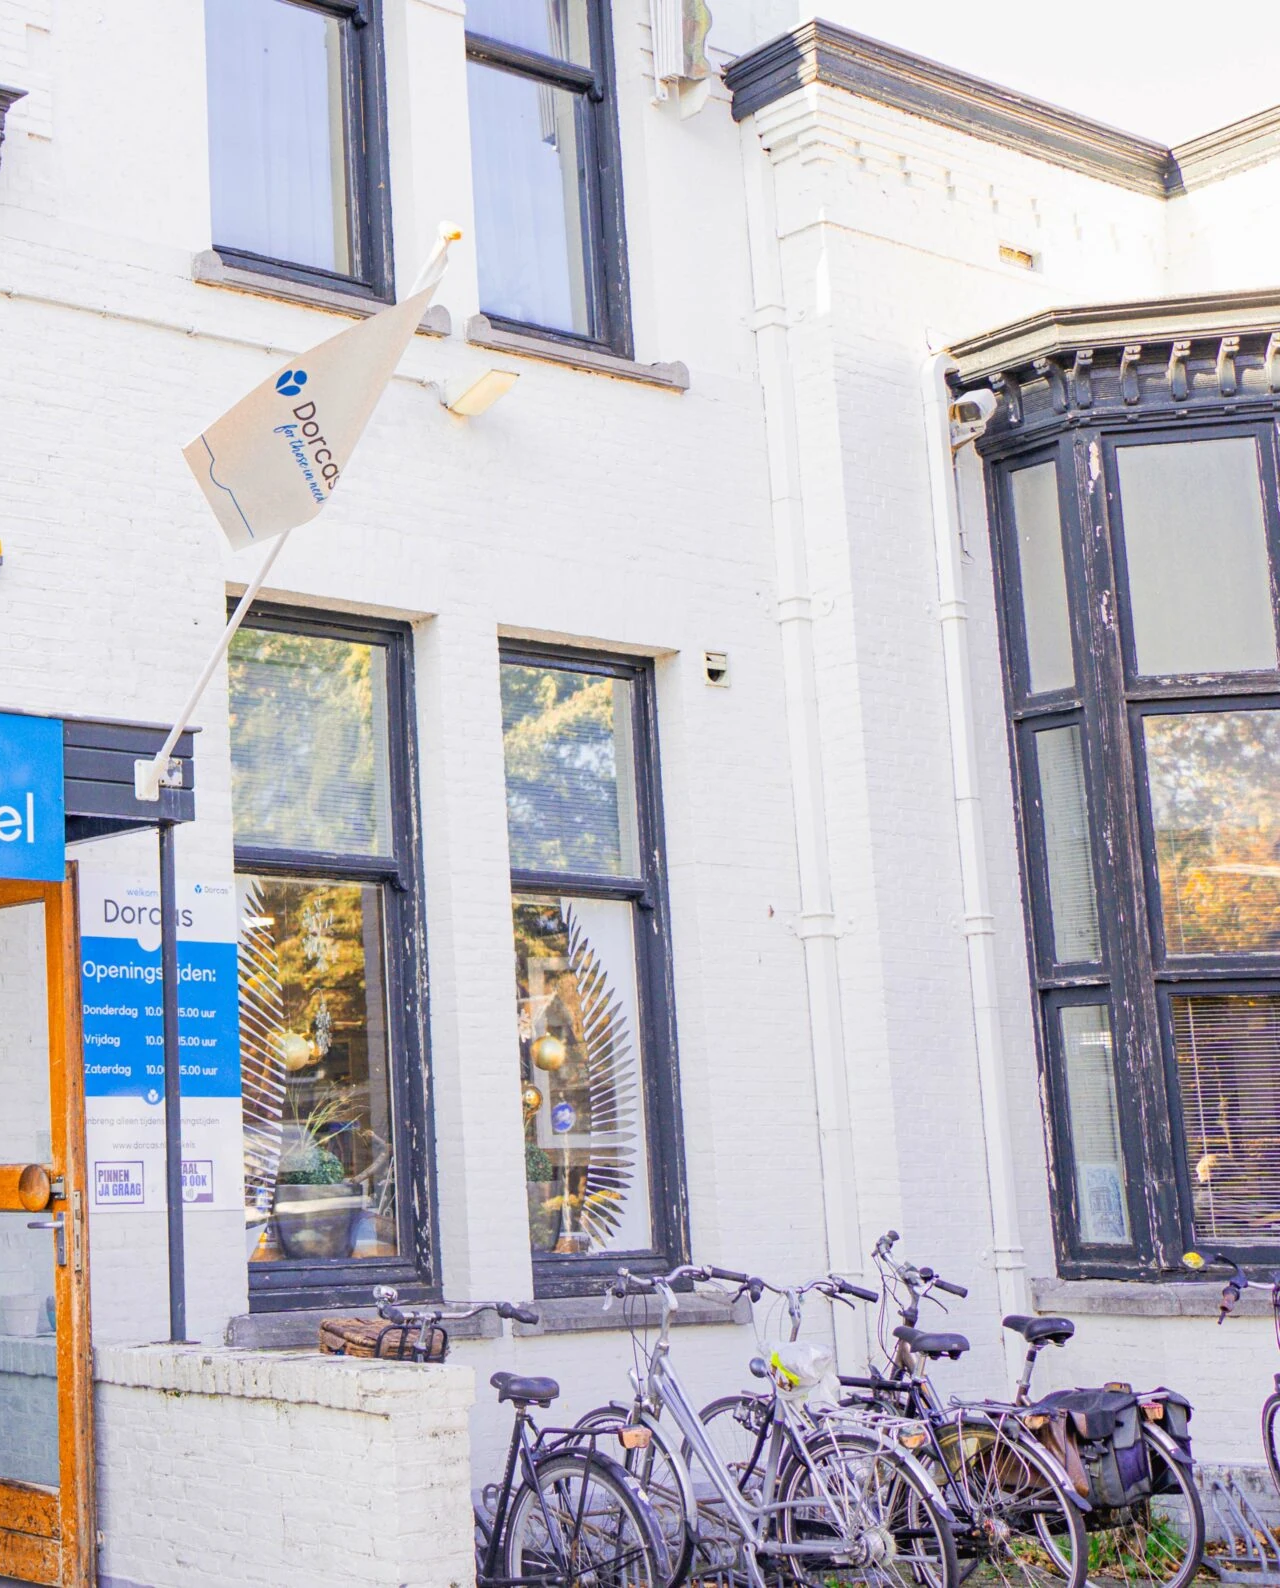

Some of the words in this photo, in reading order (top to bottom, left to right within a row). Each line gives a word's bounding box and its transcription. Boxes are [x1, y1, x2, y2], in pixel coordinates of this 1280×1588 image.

[273, 424, 298, 438] for
[289, 439, 308, 468] those
[126, 886, 159, 898] welkom
[204, 886, 229, 895] Dorcas
[104, 898, 194, 927] Dorcs
[83, 1004, 139, 1019] Donderdag
[201, 1009, 217, 1018] uur
[84, 1034, 121, 1048] Vrijdag
[202, 1038, 218, 1047] uur
[84, 1064, 132, 1078] Zaterdag
[202, 1067, 218, 1076] uur
[98, 1169, 130, 1182] PINNEN
[190, 1175, 207, 1186] OOK
[98, 1184, 110, 1196] JA
[112, 1183, 141, 1196] GRAAG
